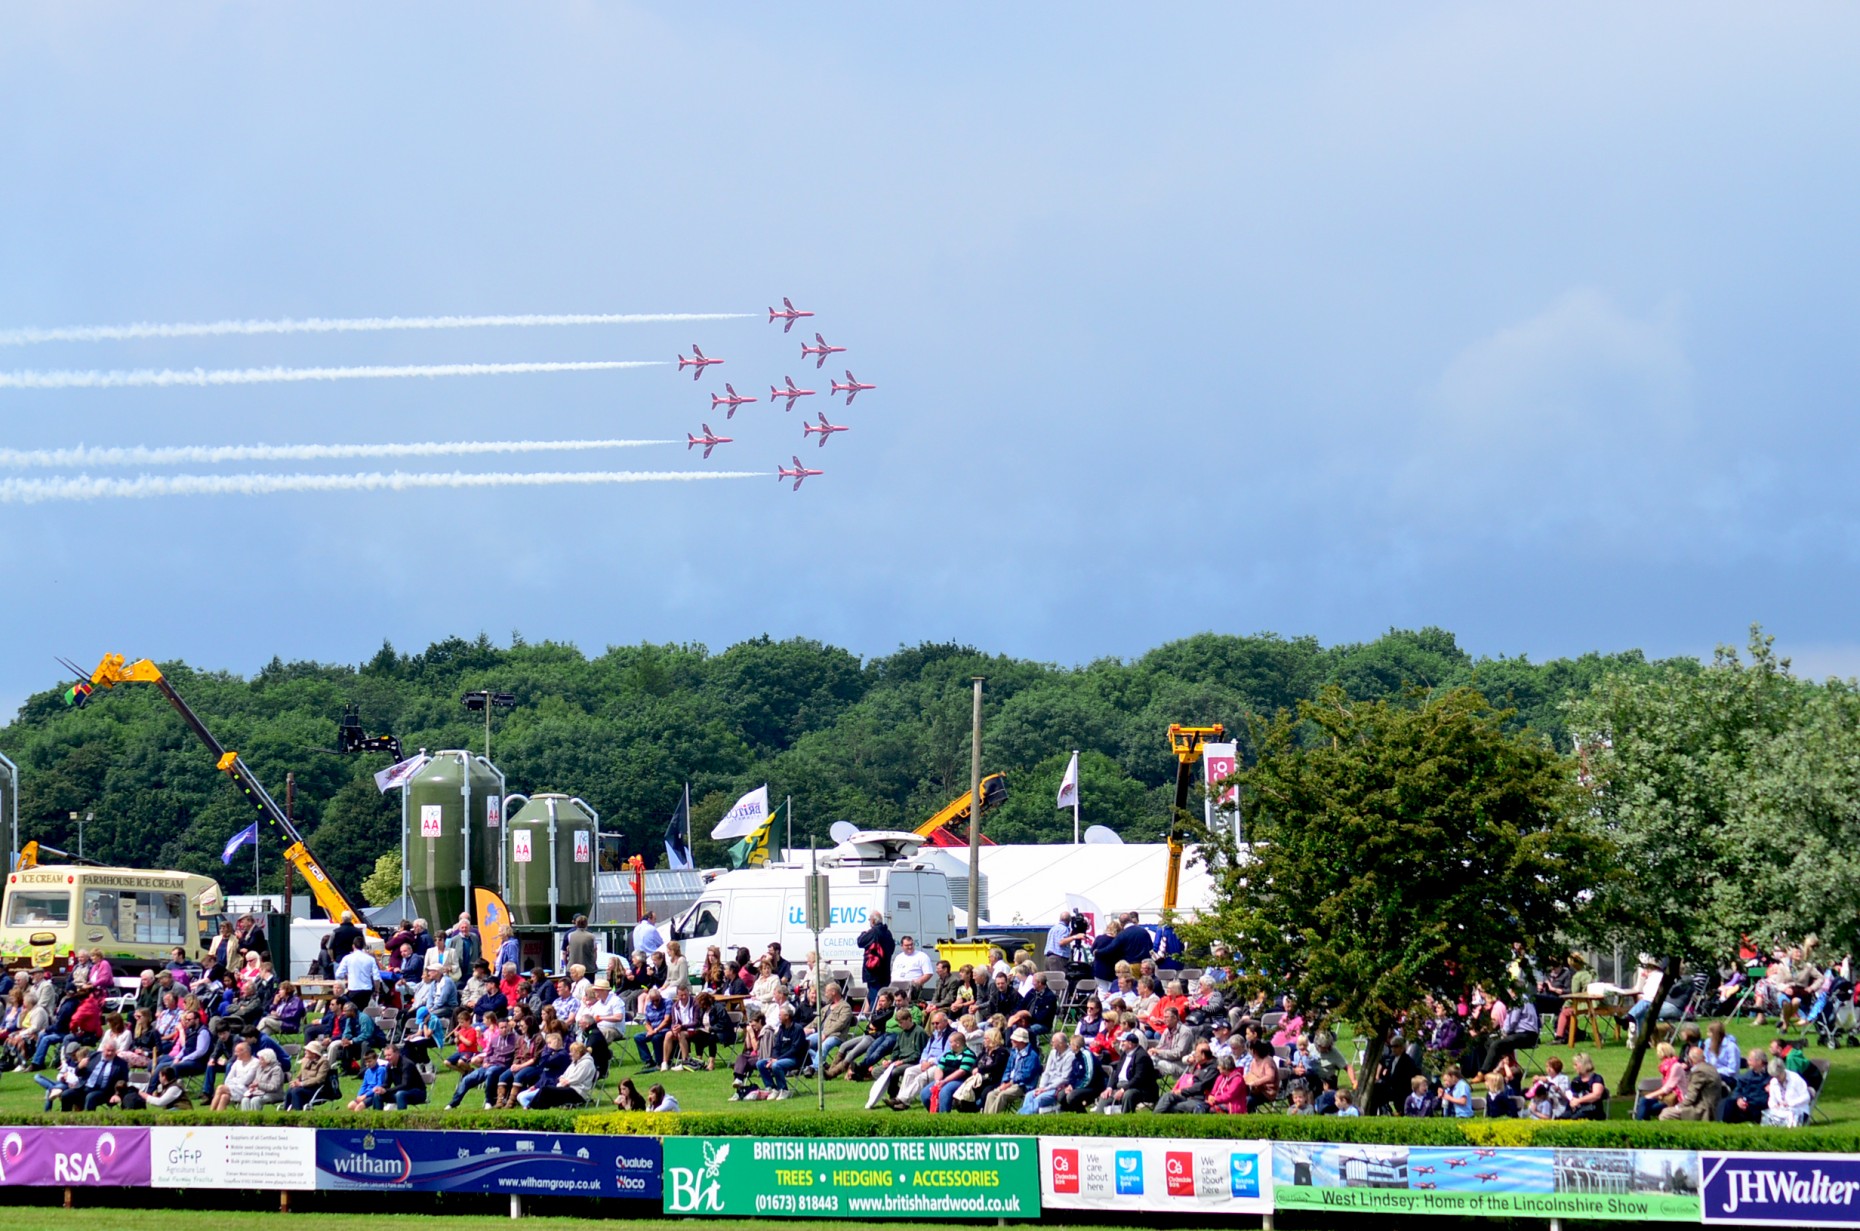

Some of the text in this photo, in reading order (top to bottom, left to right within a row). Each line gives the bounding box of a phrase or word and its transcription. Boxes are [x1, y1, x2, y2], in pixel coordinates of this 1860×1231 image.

[423, 819, 439, 830] AA
[516, 844, 529, 855] AA
[576, 844, 588, 855] AA
[22, 874, 64, 883] ICE CREAM
[308, 863, 325, 882] JCB
[82, 875, 184, 888] FARMHOUSE ICE CREAM
[829, 907, 867, 924] EWS
[754, 1142, 1020, 1161] BRITISH HARDWOOD TREE NURSERY LTD
[334, 1152, 402, 1173] witham
[615, 1155, 653, 1169] Qualube
[1086, 1154, 1100, 1164] We
[1201, 1156, 1214, 1166] We
[55, 1153, 100, 1182] RSA
[1087, 1164, 1103, 1172] care
[1201, 1167, 1217, 1175] care
[616, 1175, 646, 1189] Woco
[775, 1169, 1000, 1187] TREES HEDGING ACCESSORIES
[1086, 1172, 1109, 1182] about
[1202, 1175, 1224, 1185] about
[499, 1176, 601, 1191] www.withamgroup.co.uk
[1087, 1183, 1104, 1192] here
[1202, 1186, 1219, 1195] here
[756, 1193, 1021, 1213] (01673) 818443 www.britishhardwood.co.uk
[1321, 1190, 1649, 1214] West Lindsey: Home of the Lincolnshire Show
